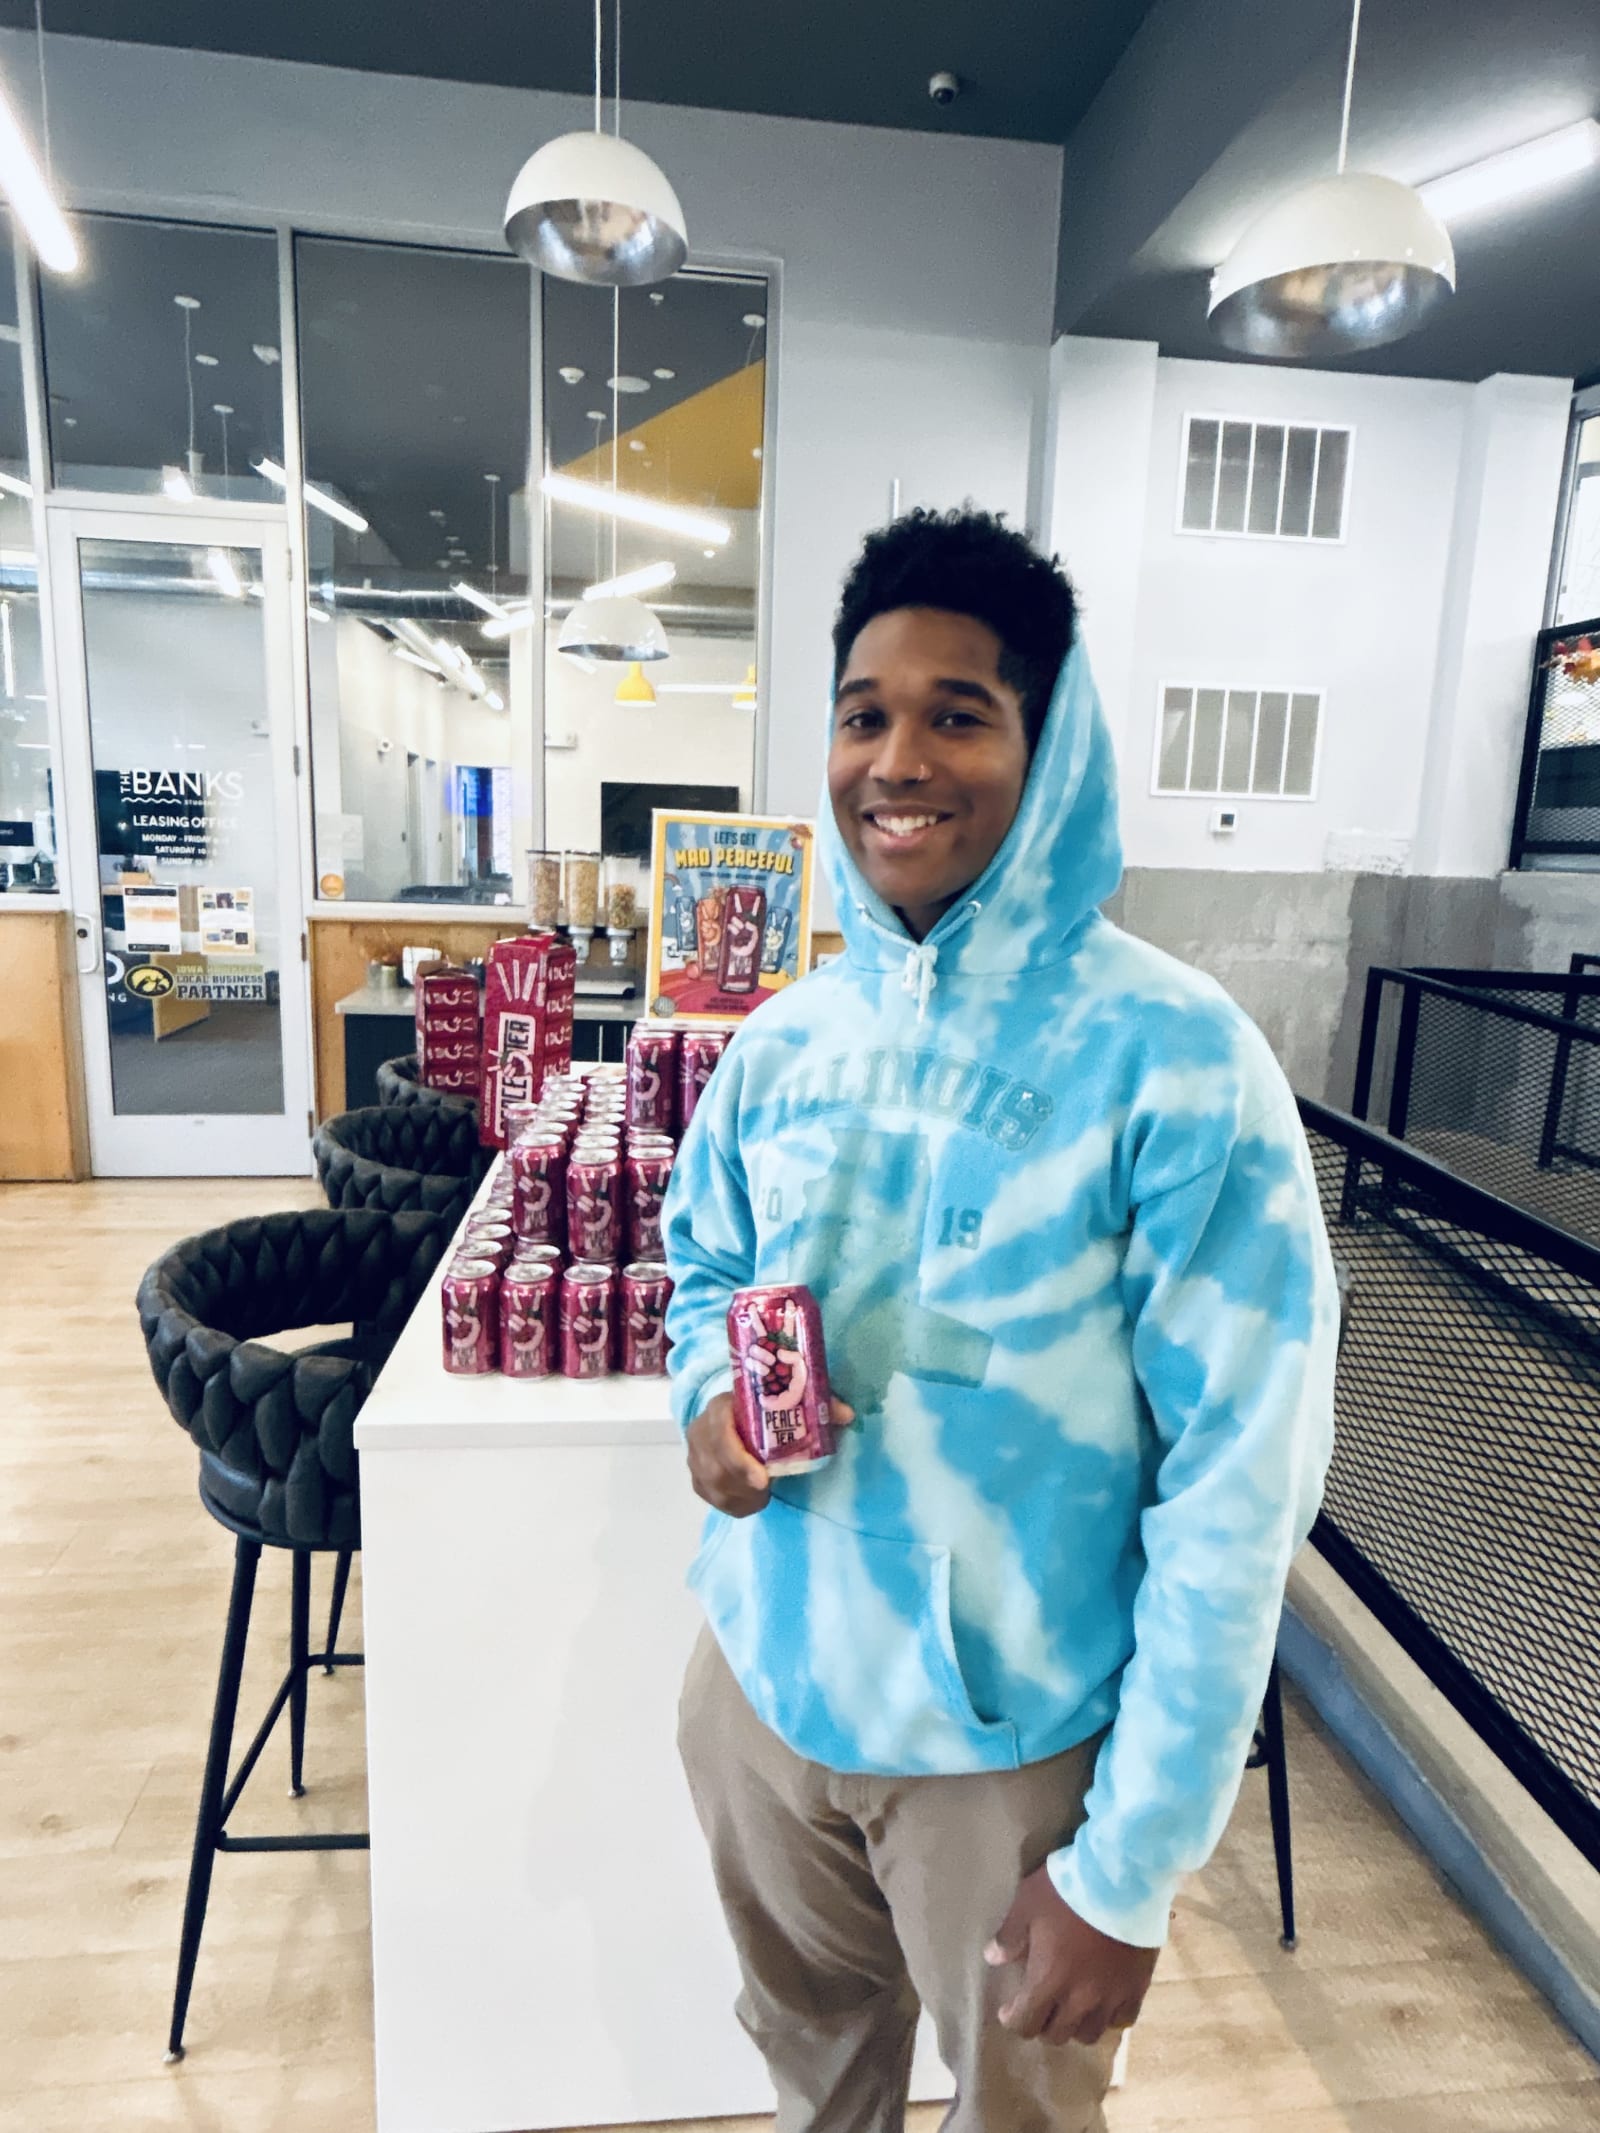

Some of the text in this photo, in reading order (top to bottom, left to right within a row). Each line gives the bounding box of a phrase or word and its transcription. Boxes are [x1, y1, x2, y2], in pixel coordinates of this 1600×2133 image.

[120, 768, 244, 800] THE BANKS
[133, 815, 239, 830] LEASING OFFICE
[142, 834, 177, 842] MONDAY
[184, 834, 212, 843] FRIDAY
[740, 832, 756, 846] GET
[155, 846, 196, 854] SATURDAY
[161, 857, 193, 866] SUNDAY
[675, 848, 794, 875] MAD PEACEFUL
[177, 965, 204, 974] IOWA
[177, 975, 263, 983] LOCAL BUSINESS
[177, 985, 265, 999] PARTNER
[772, 1046, 1054, 1151] ILLINOIS
[765, 1407, 802, 1429] PEACE
[773, 1428, 796, 1445] TEA
